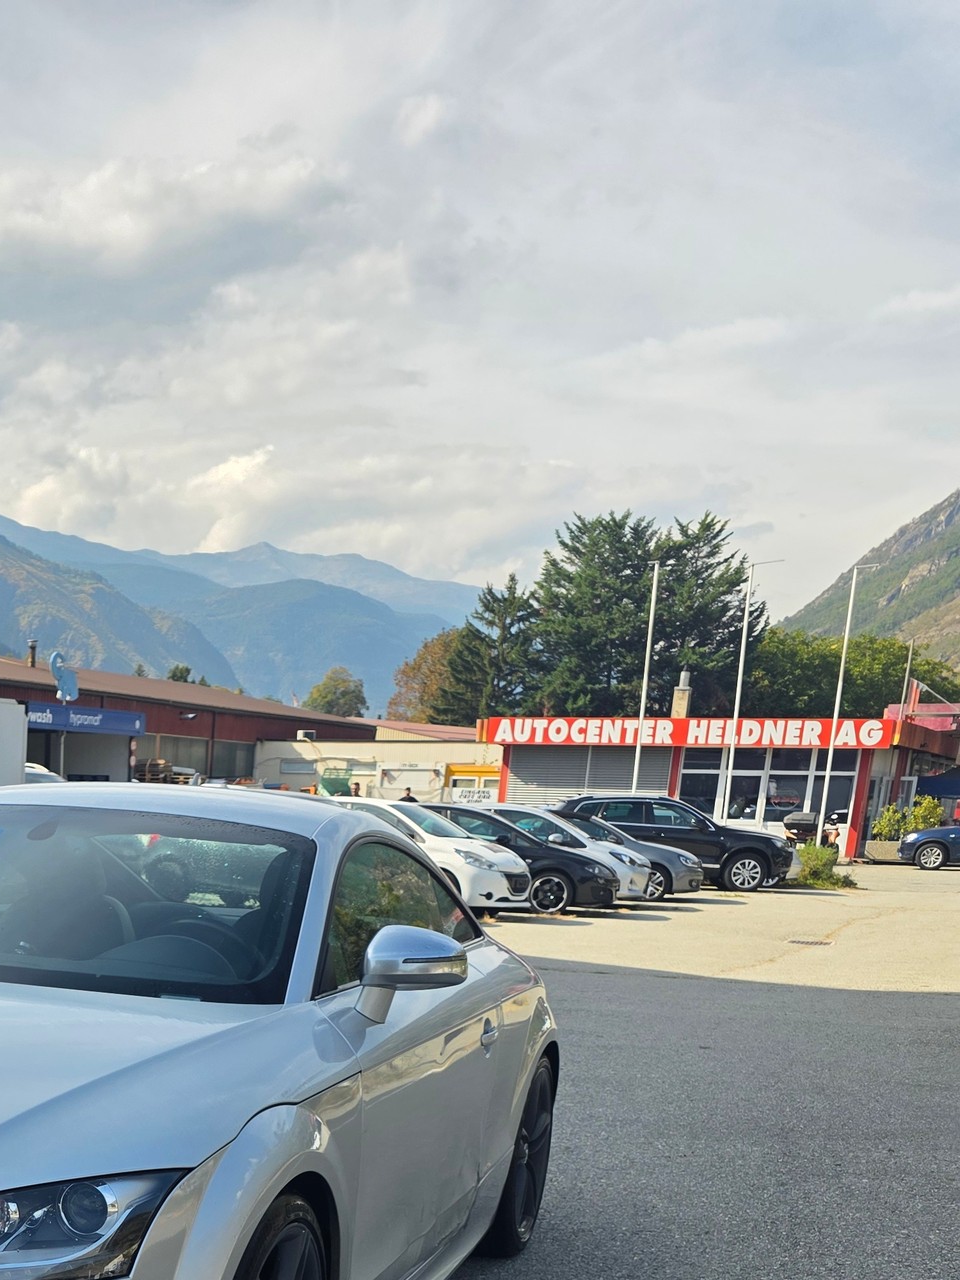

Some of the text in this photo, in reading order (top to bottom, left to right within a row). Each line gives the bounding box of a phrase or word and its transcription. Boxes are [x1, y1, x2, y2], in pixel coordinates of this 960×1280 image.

[493, 718, 884, 746] AUTOCENTER HELDNER AG
